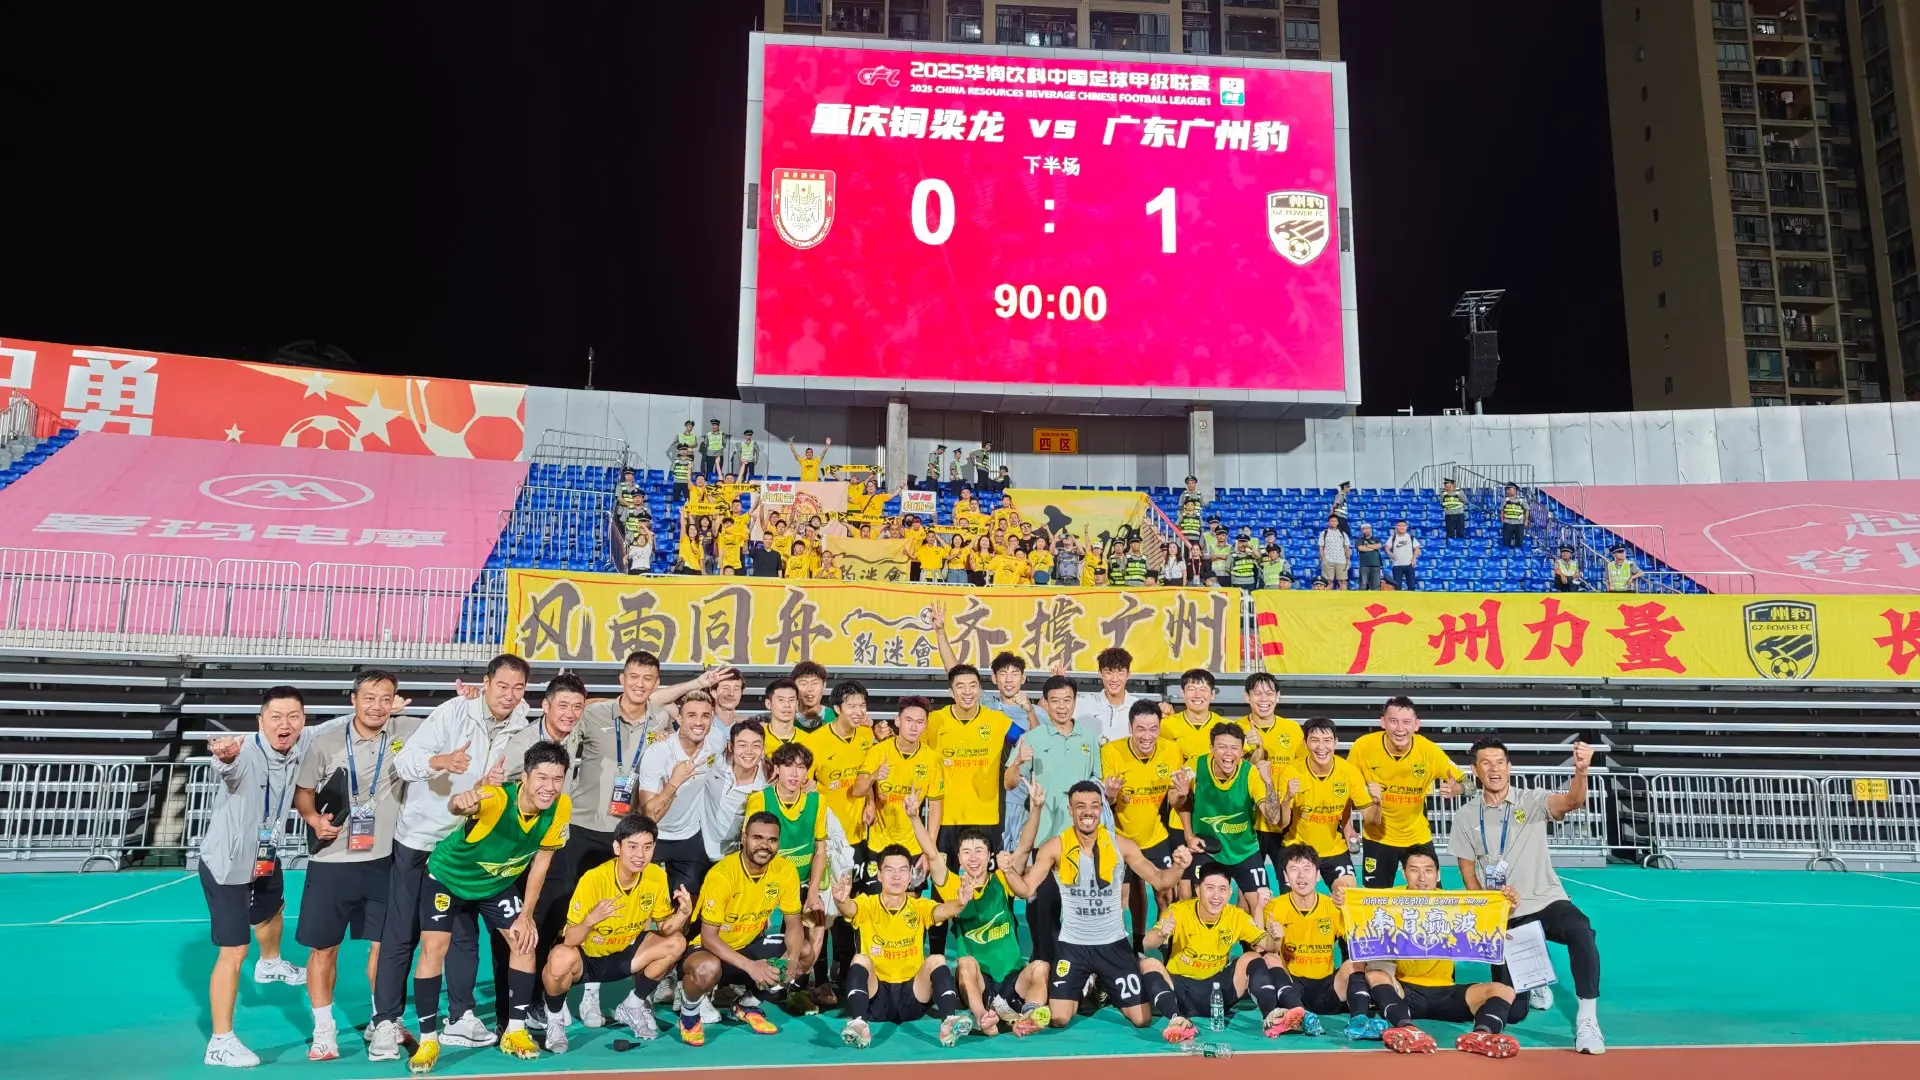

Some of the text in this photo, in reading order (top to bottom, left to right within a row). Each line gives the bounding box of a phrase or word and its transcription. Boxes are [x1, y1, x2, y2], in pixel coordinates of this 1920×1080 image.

[910, 84, 933, 93] 2025
[935, 84, 965, 95] CHINA
[968, 86, 1023, 98] RESOURCES
[1025, 89, 1076, 100] BEVERAGE
[1078, 91, 1117, 102] CHINESE
[1119, 94, 1168, 104] FOOTBALL
[811, 103, 1005, 142] 重庆铜梁龙
[1102, 115, 1290, 152] 广东广州豹
[1023, 155, 1081, 177] 下半场
[1271, 195, 1325, 209] 广州豹
[911, 178, 956, 245] 0
[1145, 187, 1177, 253] 1
[994, 283, 1107, 321] 90:00
[32, 513, 447, 547] 爱玛电摩
[521, 581, 834, 665] 风雨同舟
[1751, 606, 1810, 621] 广州豹
[1346, 596, 1687, 674] 广州力量
[1250, 868, 1267, 886] 17
[1075, 907, 1112, 917] JESUS
[1084, 898, 1103, 907] TO
[1362, 896, 1389, 905] MAKE
[1392, 896, 1430, 906] DREAMS
[1115, 973, 1141, 999] 20
